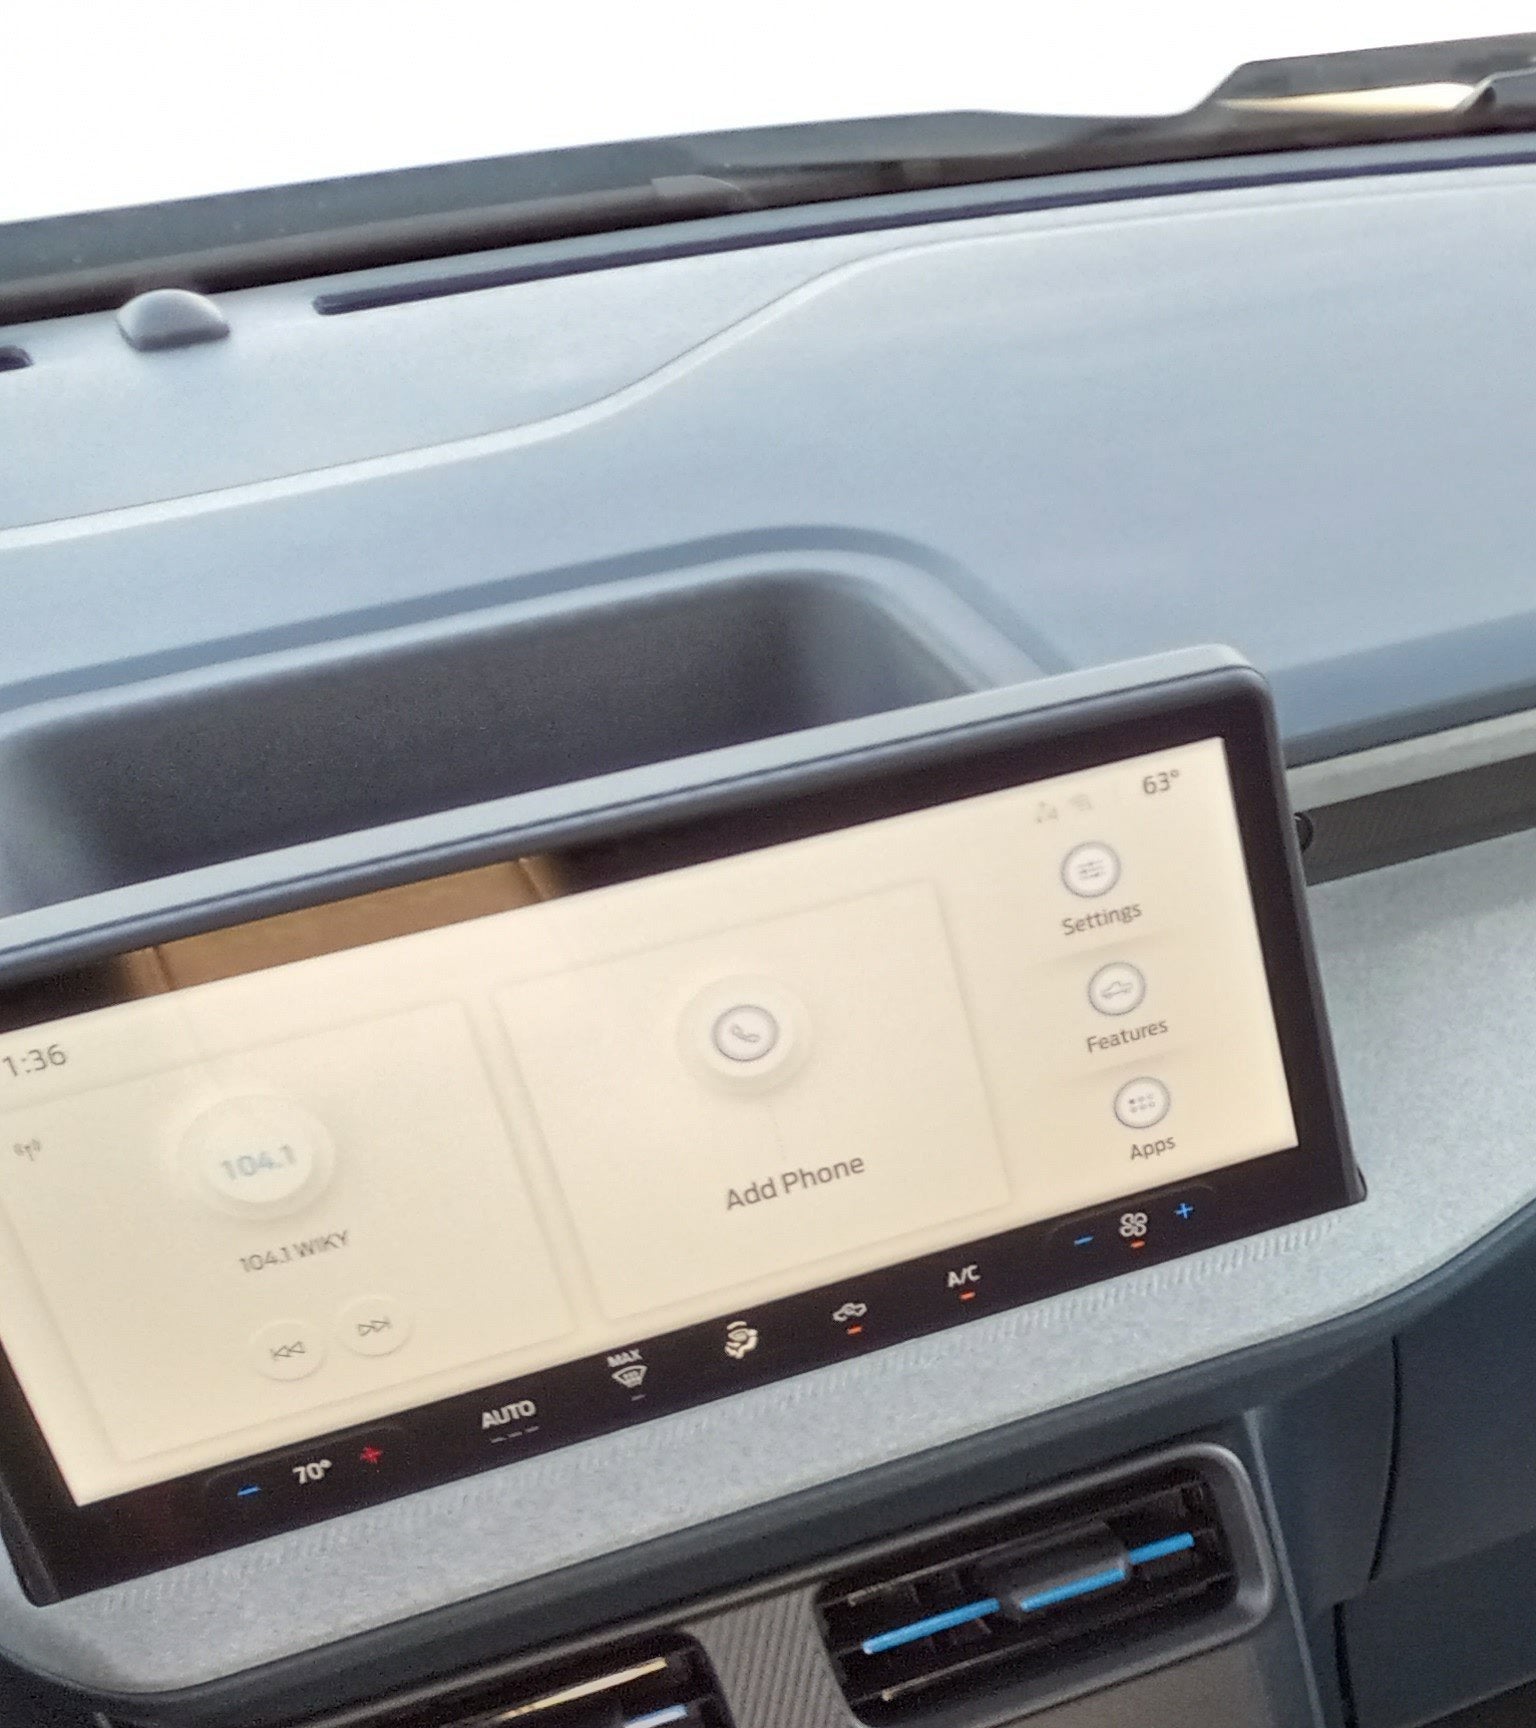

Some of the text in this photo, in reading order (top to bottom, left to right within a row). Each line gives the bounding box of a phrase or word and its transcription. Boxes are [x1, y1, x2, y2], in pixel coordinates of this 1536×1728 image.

[1142, 769, 1181, 796] 63°
[1061, 901, 1143, 936] Settings
[1086, 1019, 1168, 1054] Features
[3, 1044, 66, 1077] 1:36
[220, 1143, 297, 1182] 104.1
[1129, 1134, 1176, 1161] Apps
[725, 1154, 865, 1211] Add Phone
[296, 1229, 350, 1259] WIKY
[947, 1264, 980, 1289] A/C
[606, 1348, 642, 1368] MAX
[480, 1400, 536, 1430] AUTO
